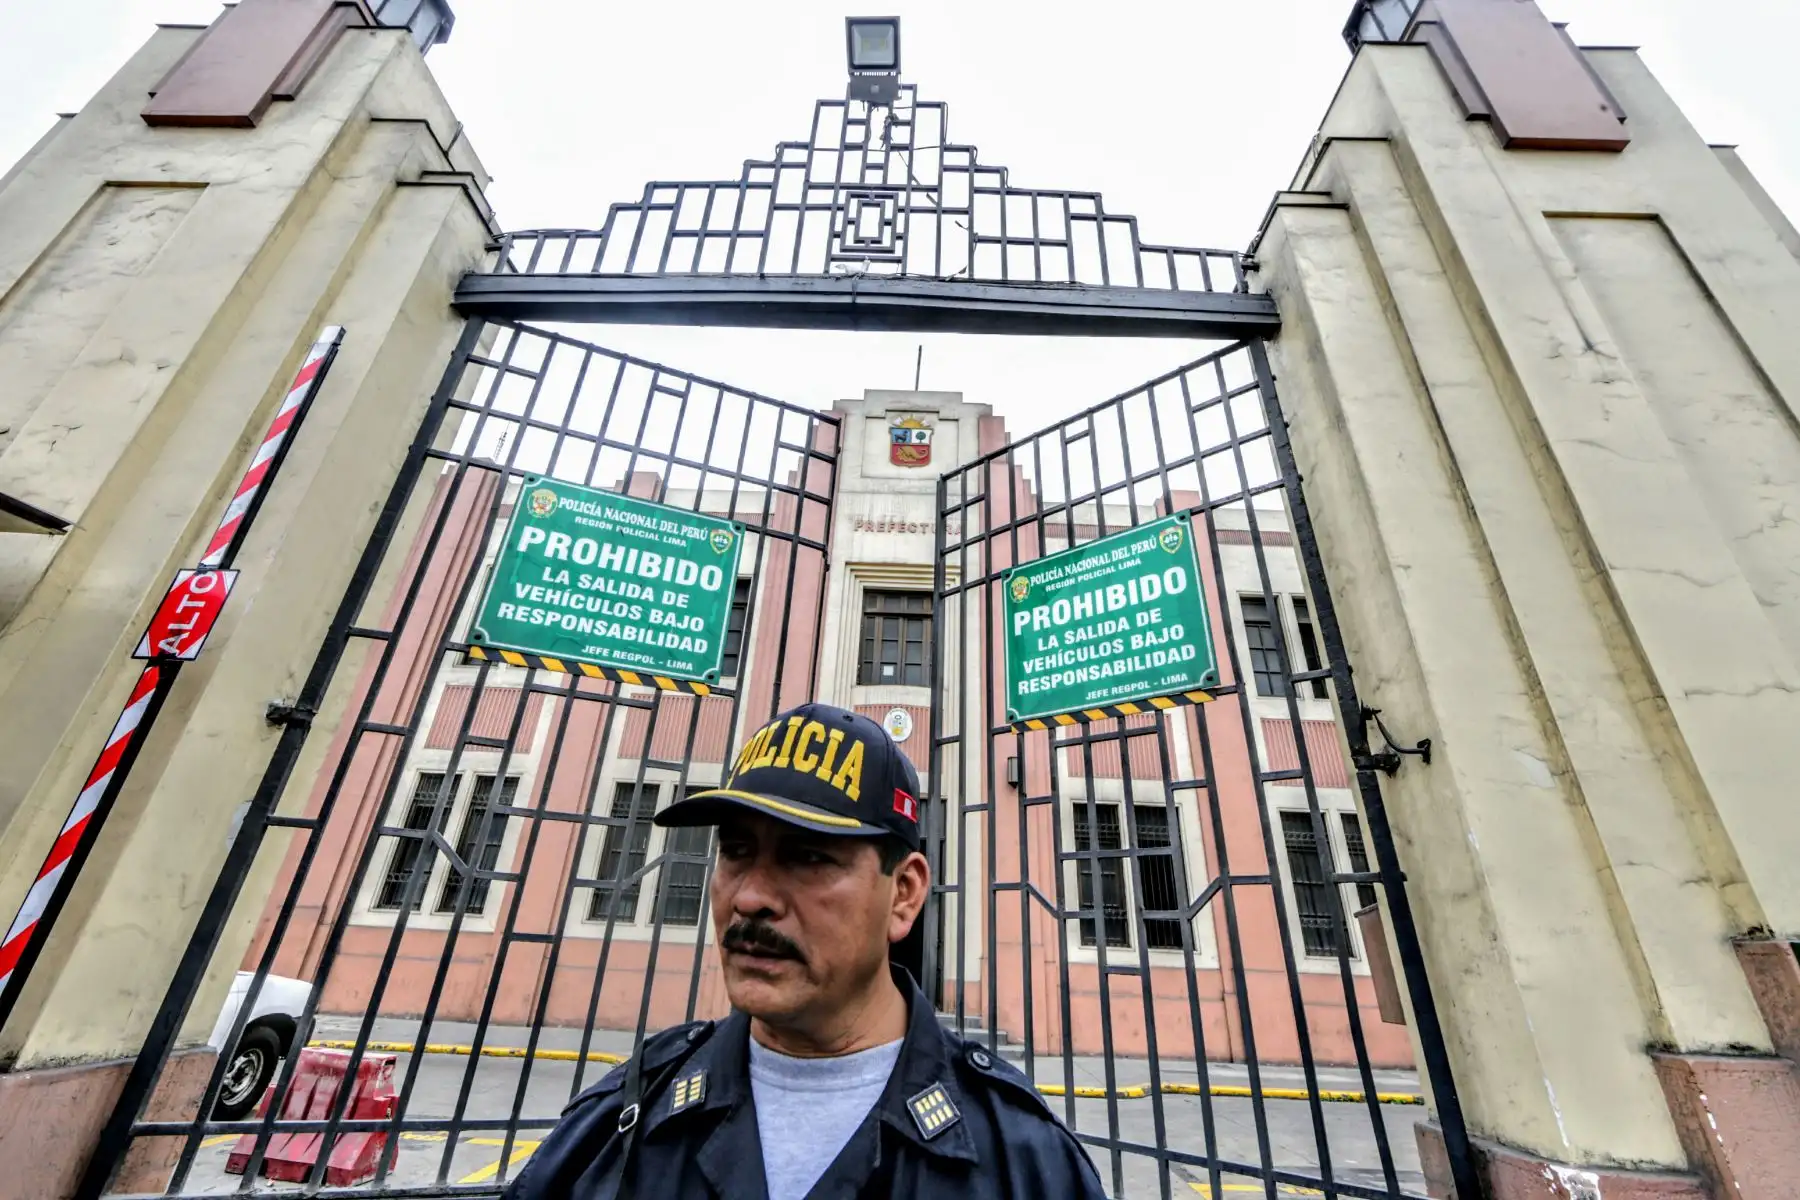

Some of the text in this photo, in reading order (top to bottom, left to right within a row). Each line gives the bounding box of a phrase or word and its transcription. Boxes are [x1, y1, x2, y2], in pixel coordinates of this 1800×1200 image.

[558, 497, 708, 541] POLICÍA NACIONAL DEL PERÚ
[614, 526, 660, 541] POLICIAL
[663, 536, 686, 547] LIMA
[517, 526, 722, 592] PROHIBIDO
[1030, 535, 1157, 586] POLICÍA NACIONAL DEL PERÚ
[1077, 566, 1116, 583] POLICIAL
[1118, 558, 1142, 570] LIMA
[515, 582, 704, 632] VEHÍCULOS BAJO
[542, 568, 690, 608] LA SALIDA DE
[1014, 566, 1187, 636] PROHIBIDO
[158, 572, 218, 656] ALTO
[498, 603, 708, 654] RESPONSABILIDAD
[1038, 608, 1162, 651] LA SALIDA DE
[582, 644, 610, 658] JEFE
[612, 650, 656, 664] REGPOL
[666, 660, 693, 671] LIMA
[1018, 644, 1196, 695] RESPONSABILIDAD
[1023, 624, 1184, 674] VEHÍCULOS BAJO
[1085, 688, 1109, 700] JEFE
[1111, 681, 1150, 695] REGPOL
[1161, 673, 1188, 686] LIMA
[727, 716, 864, 802] POLICIA
